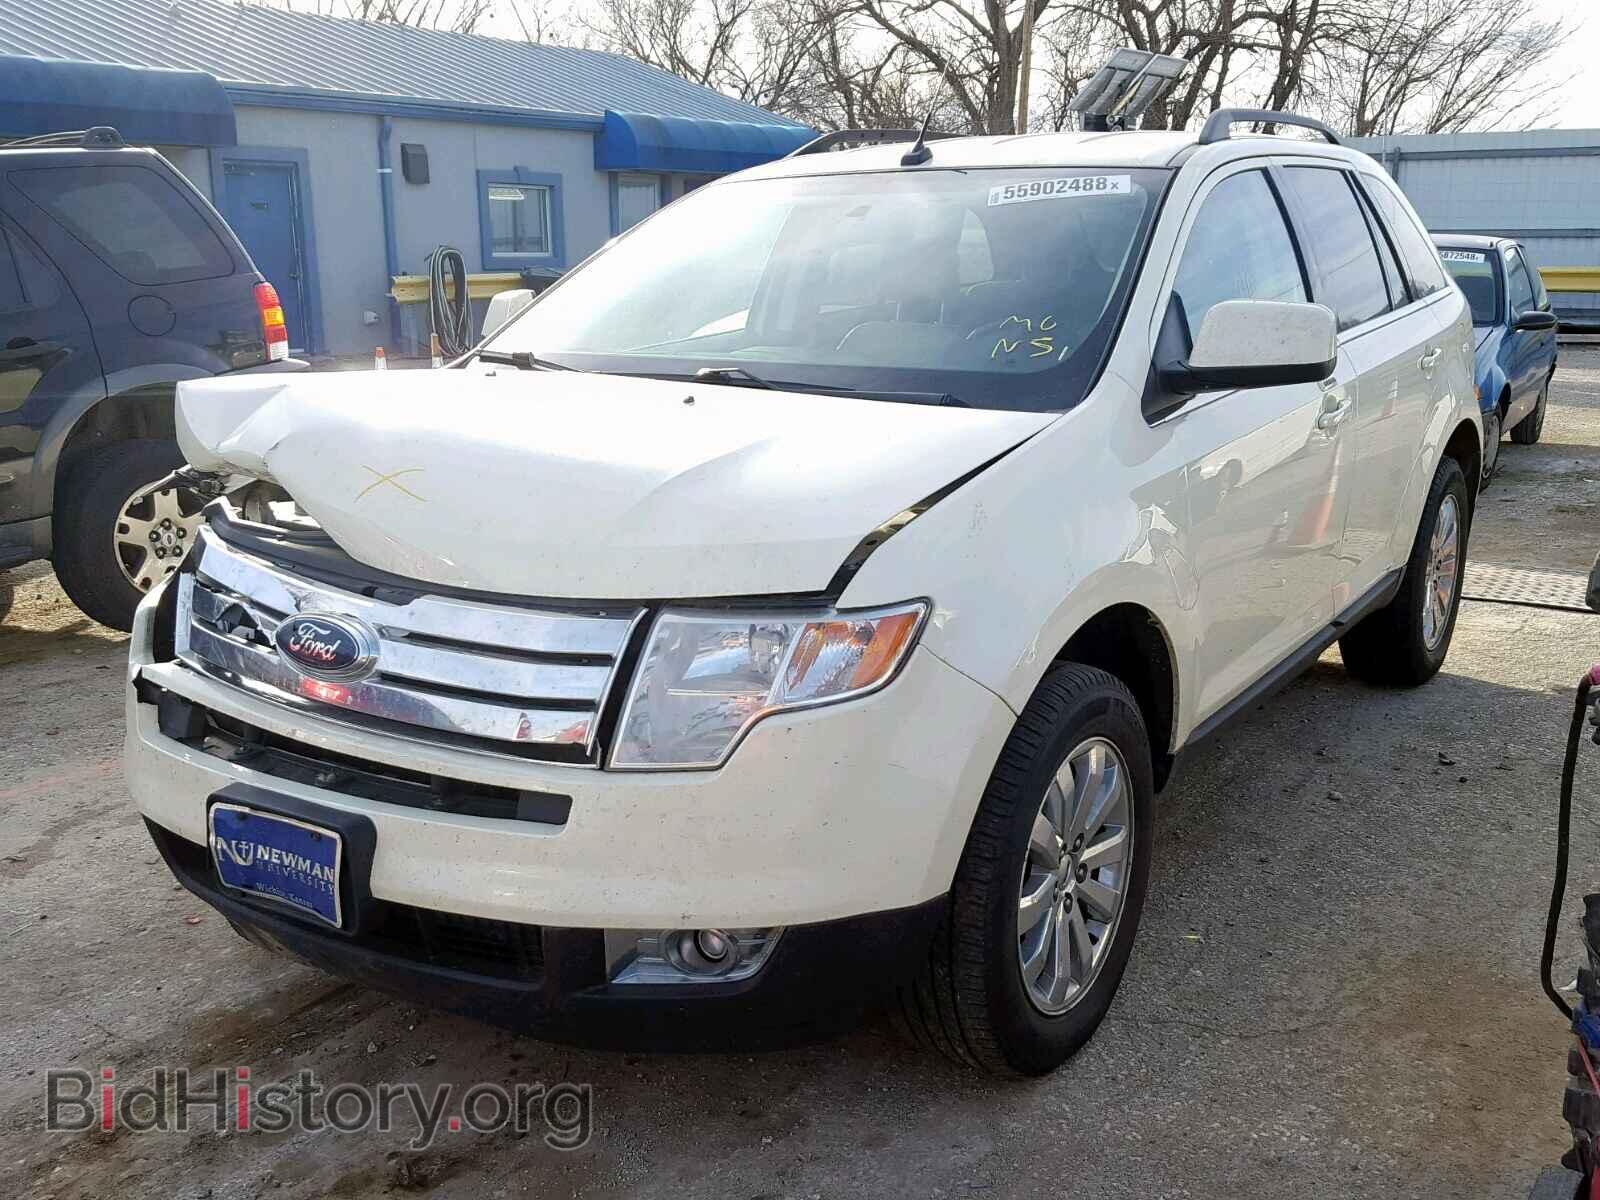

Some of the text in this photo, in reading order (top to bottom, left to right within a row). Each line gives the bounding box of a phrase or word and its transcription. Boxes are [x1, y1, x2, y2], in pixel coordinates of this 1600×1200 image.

[1003, 176, 1108, 201] 55902488
[288, 622, 342, 662] Ford
[256, 843, 335, 882] NEWMAN
[256, 860, 335, 895] UNIVERSITY
